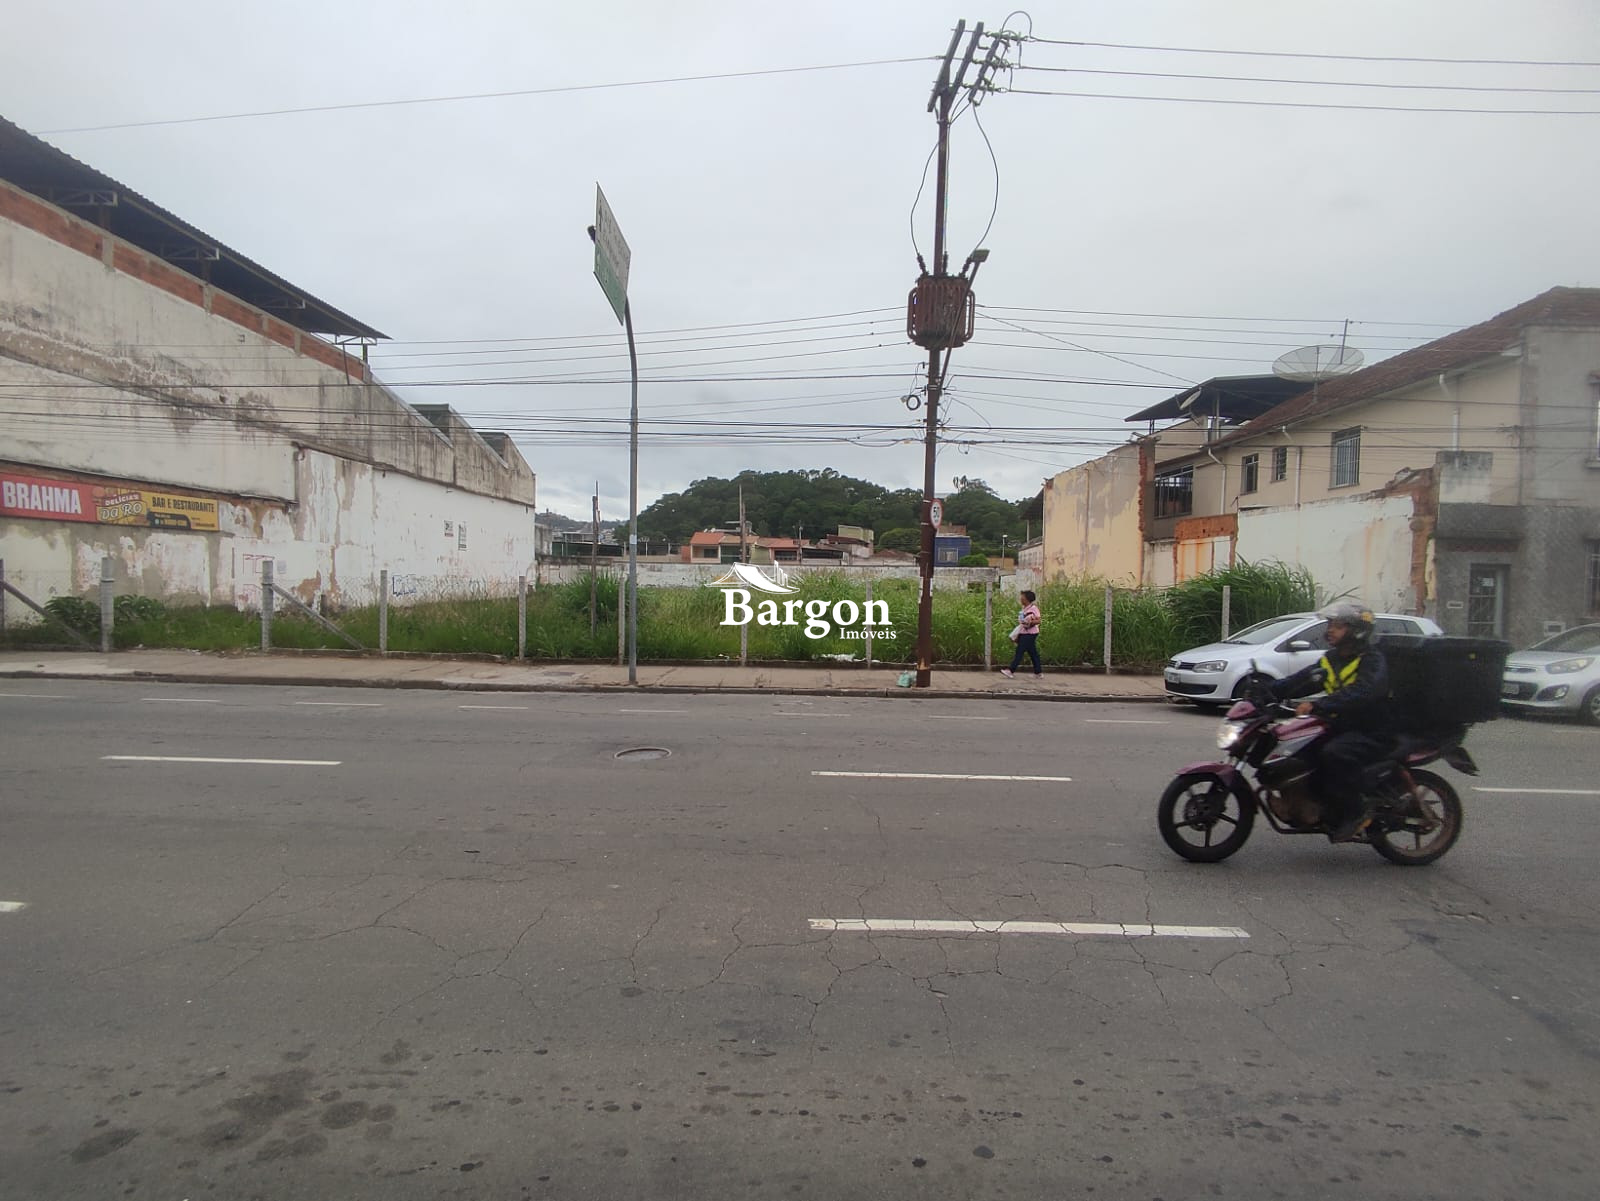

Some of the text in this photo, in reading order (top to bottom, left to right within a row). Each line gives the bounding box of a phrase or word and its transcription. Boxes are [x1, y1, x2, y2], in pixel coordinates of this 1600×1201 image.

[2, 481, 82, 514] BRAHMA
[152, 496, 214, 513] BAR E RESTAURANTE
